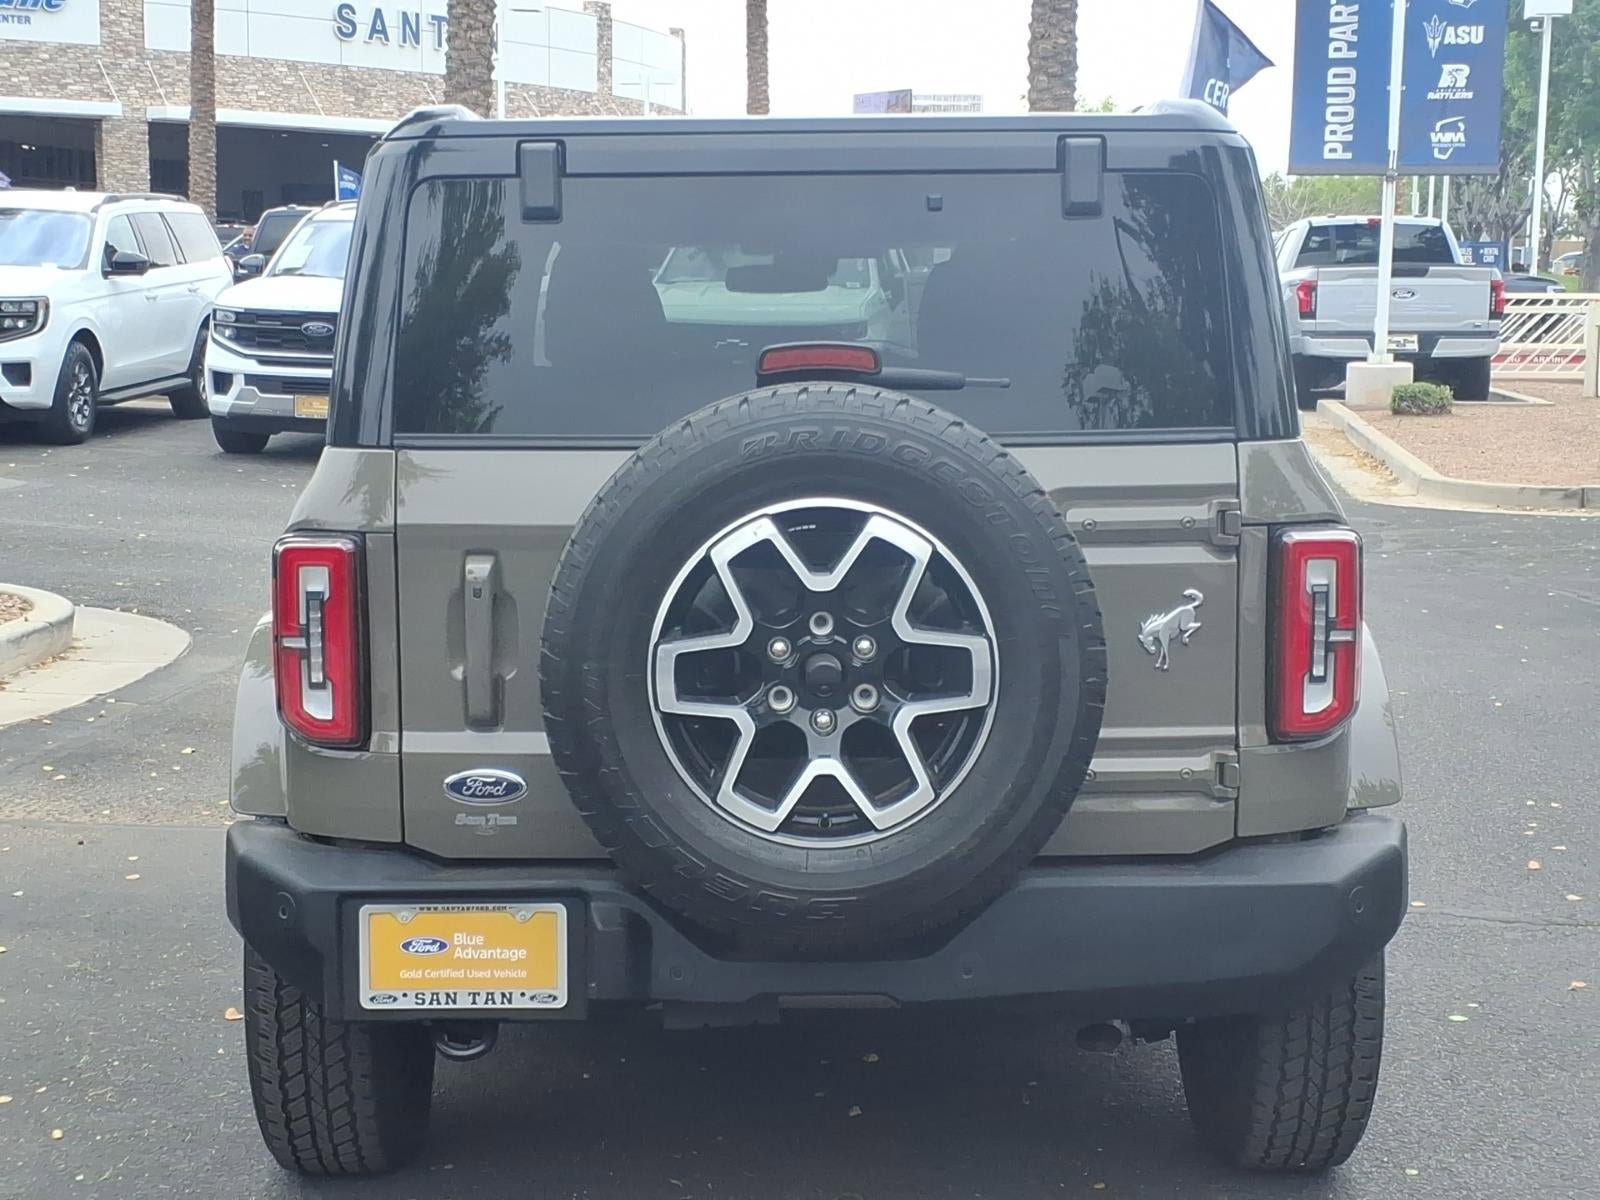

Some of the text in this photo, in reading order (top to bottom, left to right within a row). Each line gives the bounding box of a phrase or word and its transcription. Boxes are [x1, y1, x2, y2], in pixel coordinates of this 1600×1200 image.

[0, 14, 31, 25] NTER
[1443, 25, 1484, 45] ASU
[1323, 67, 1357, 160] PROUD
[462, 776, 508, 797] Ford
[408, 939, 441, 953] Ford
[453, 933, 484, 945] Blue
[453, 947, 527, 961] Advantage
[400, 969, 527, 979] Gold Certified Used Vehicle
[414, 992, 458, 1005] SAN
[468, 992, 514, 1005] TAN
